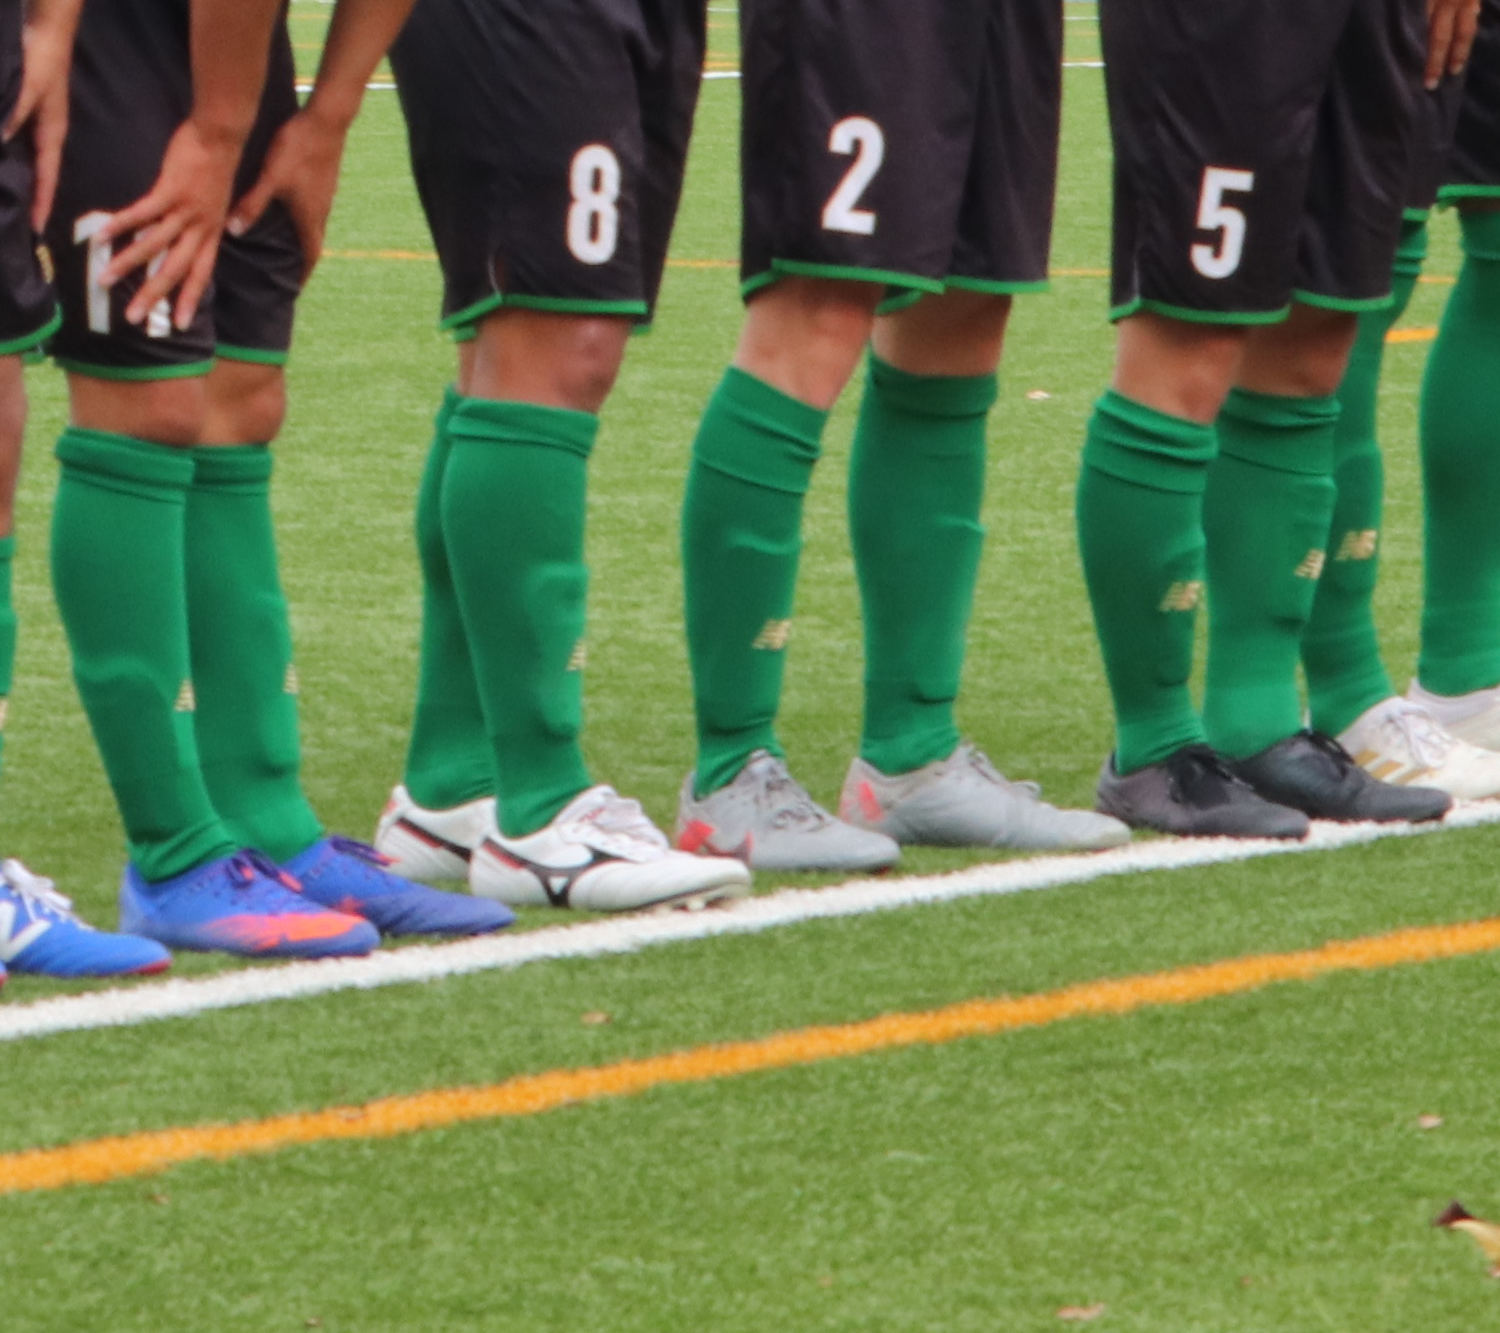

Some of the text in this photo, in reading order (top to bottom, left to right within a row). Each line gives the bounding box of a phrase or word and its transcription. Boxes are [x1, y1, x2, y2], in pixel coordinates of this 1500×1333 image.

[567, 143, 621, 265] 8
[821, 115, 885, 235] 2
[1190, 165, 1255, 279] 5
